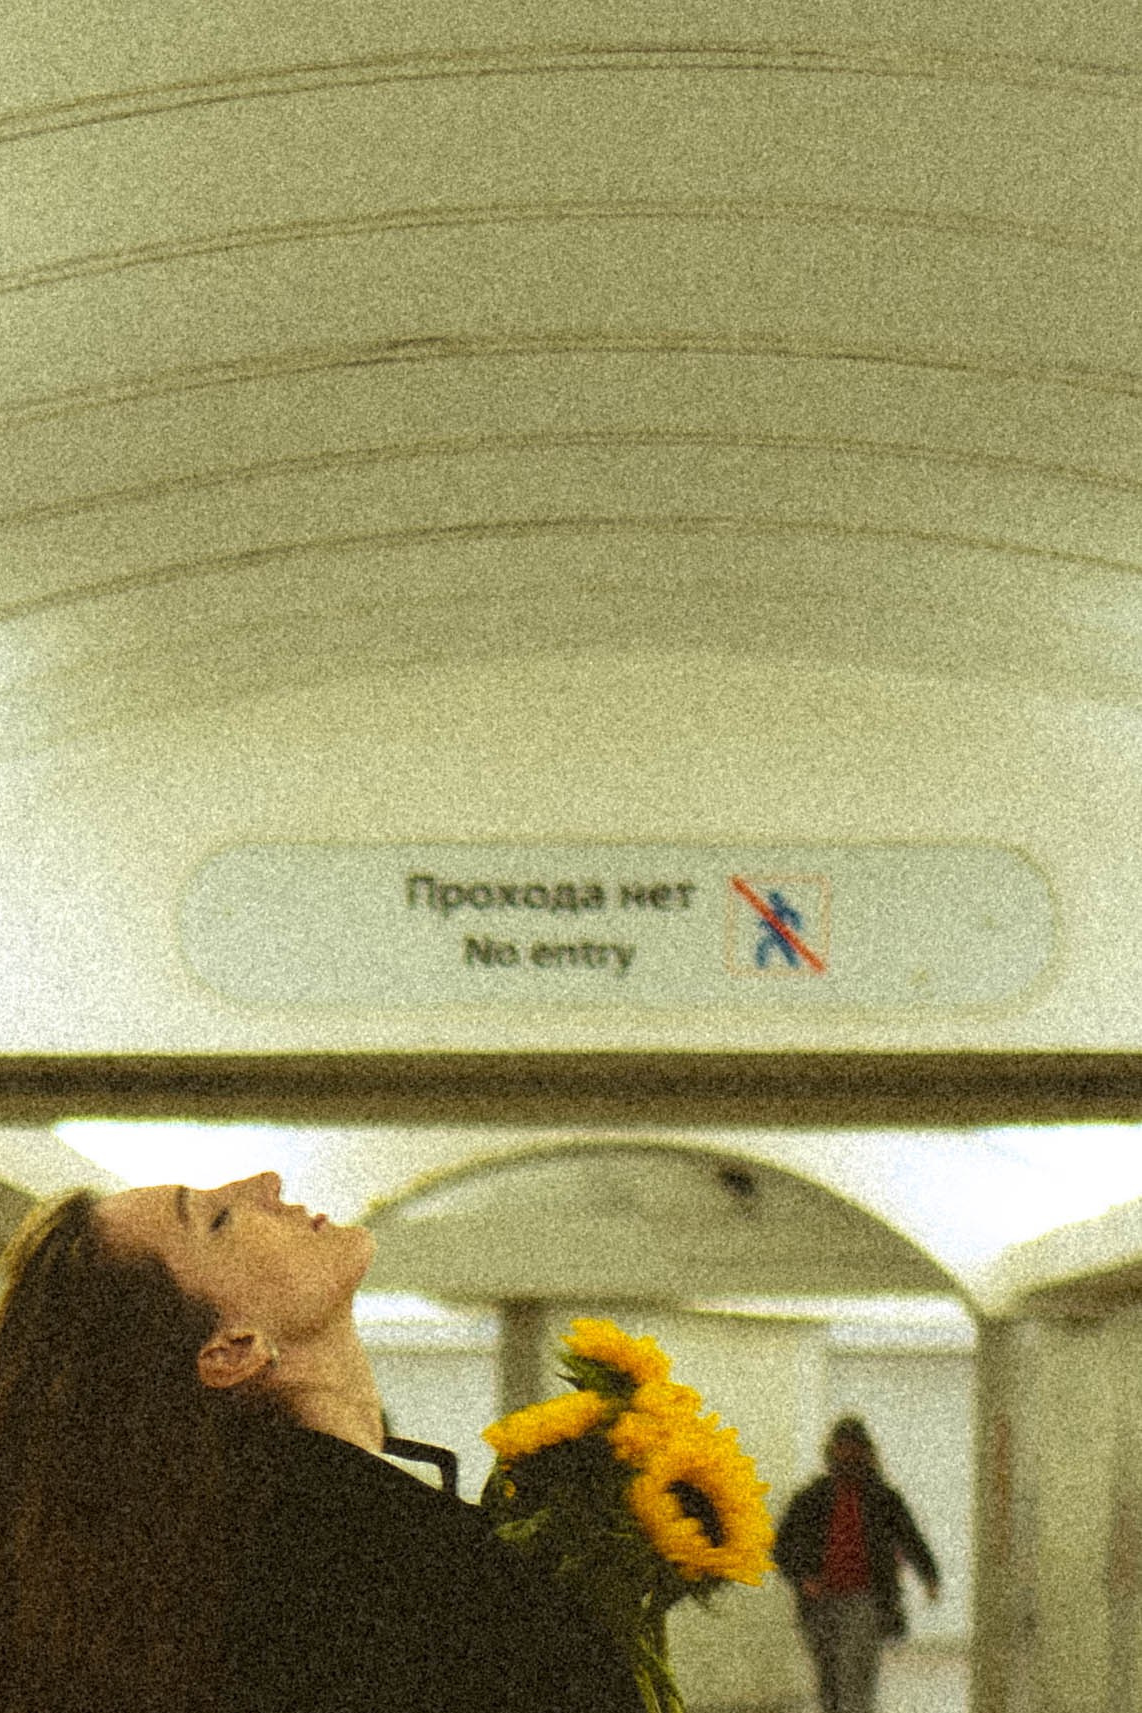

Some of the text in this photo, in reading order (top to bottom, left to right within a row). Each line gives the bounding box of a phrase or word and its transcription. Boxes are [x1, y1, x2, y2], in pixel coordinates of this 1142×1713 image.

[407, 874, 697, 916] Прохода нет
[465, 937, 635, 976] No entry
